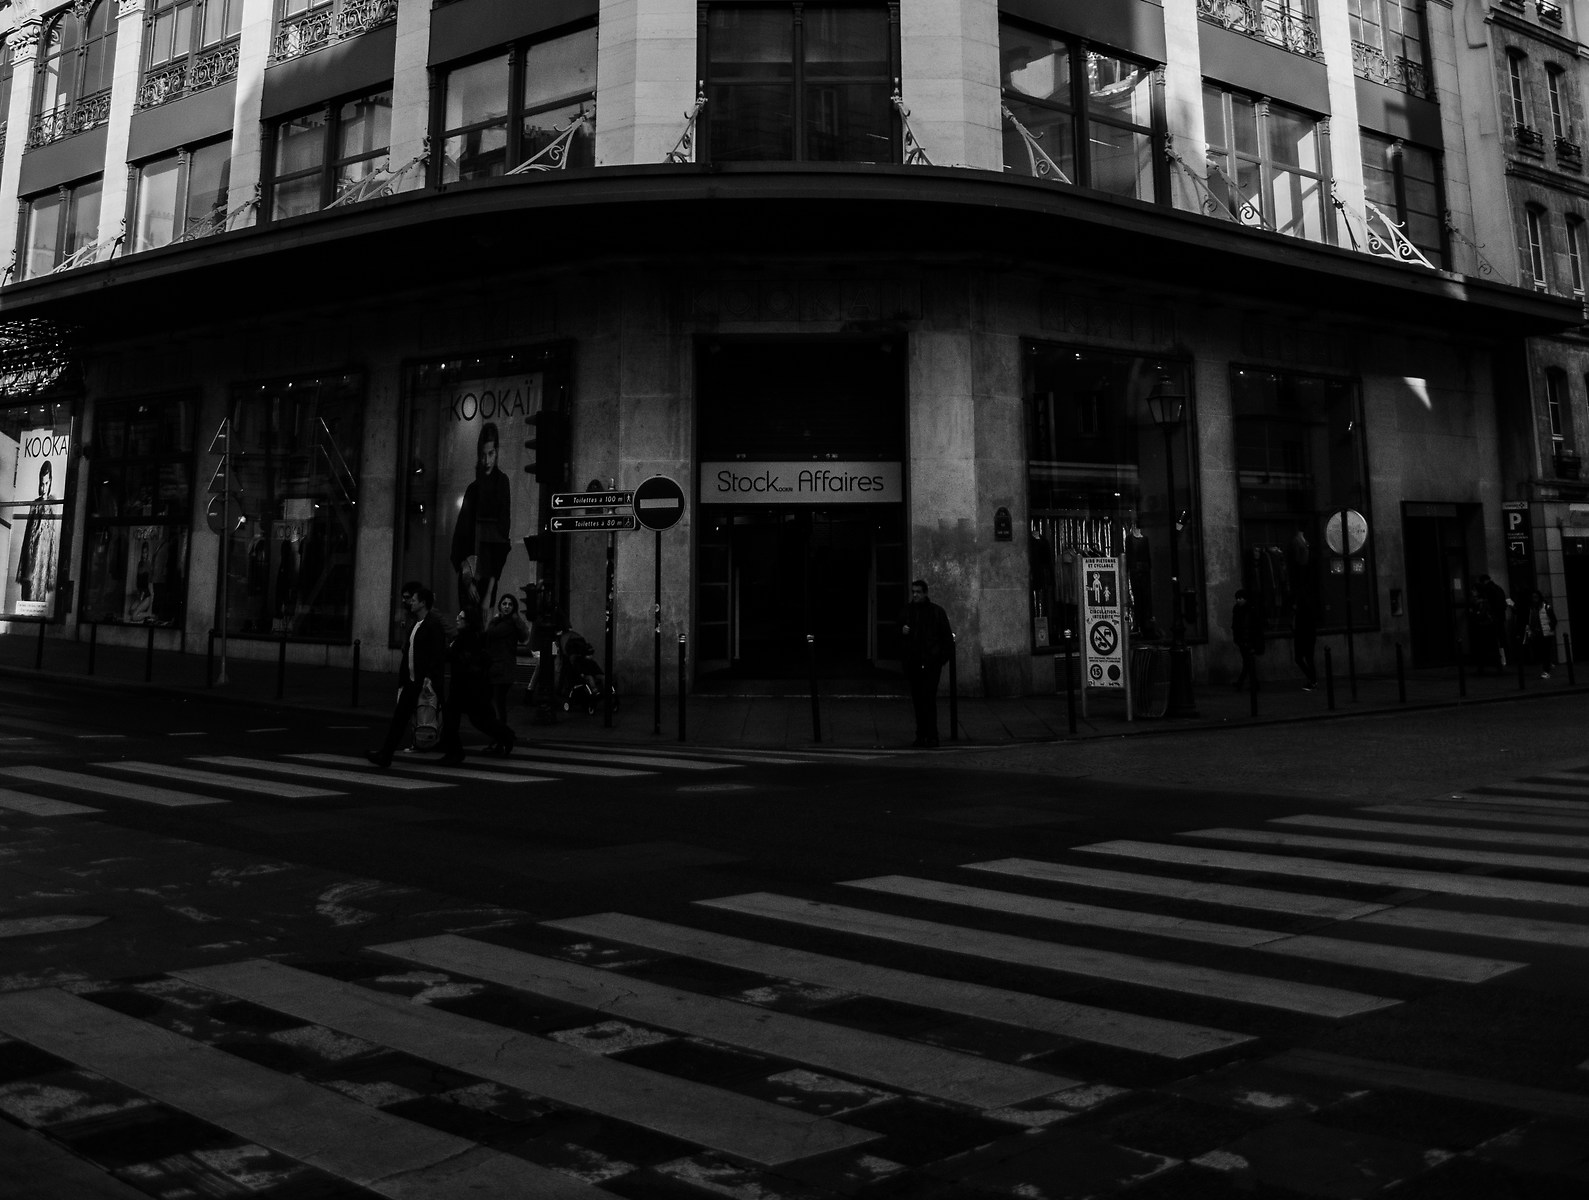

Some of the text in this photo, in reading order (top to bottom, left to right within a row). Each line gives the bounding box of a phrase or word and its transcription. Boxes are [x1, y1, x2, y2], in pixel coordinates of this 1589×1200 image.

[449, 379, 533, 421] KOOKAÏ
[24, 436, 68, 458] KOOKA
[717, 470, 779, 492] Stock
[798, 470, 884, 492] Affaires
[573, 496, 598, 504] Toilettes
[605, 495, 617, 503] 100
[1508, 512, 1522, 531] P
[1093, 668, 1101, 676] 15
